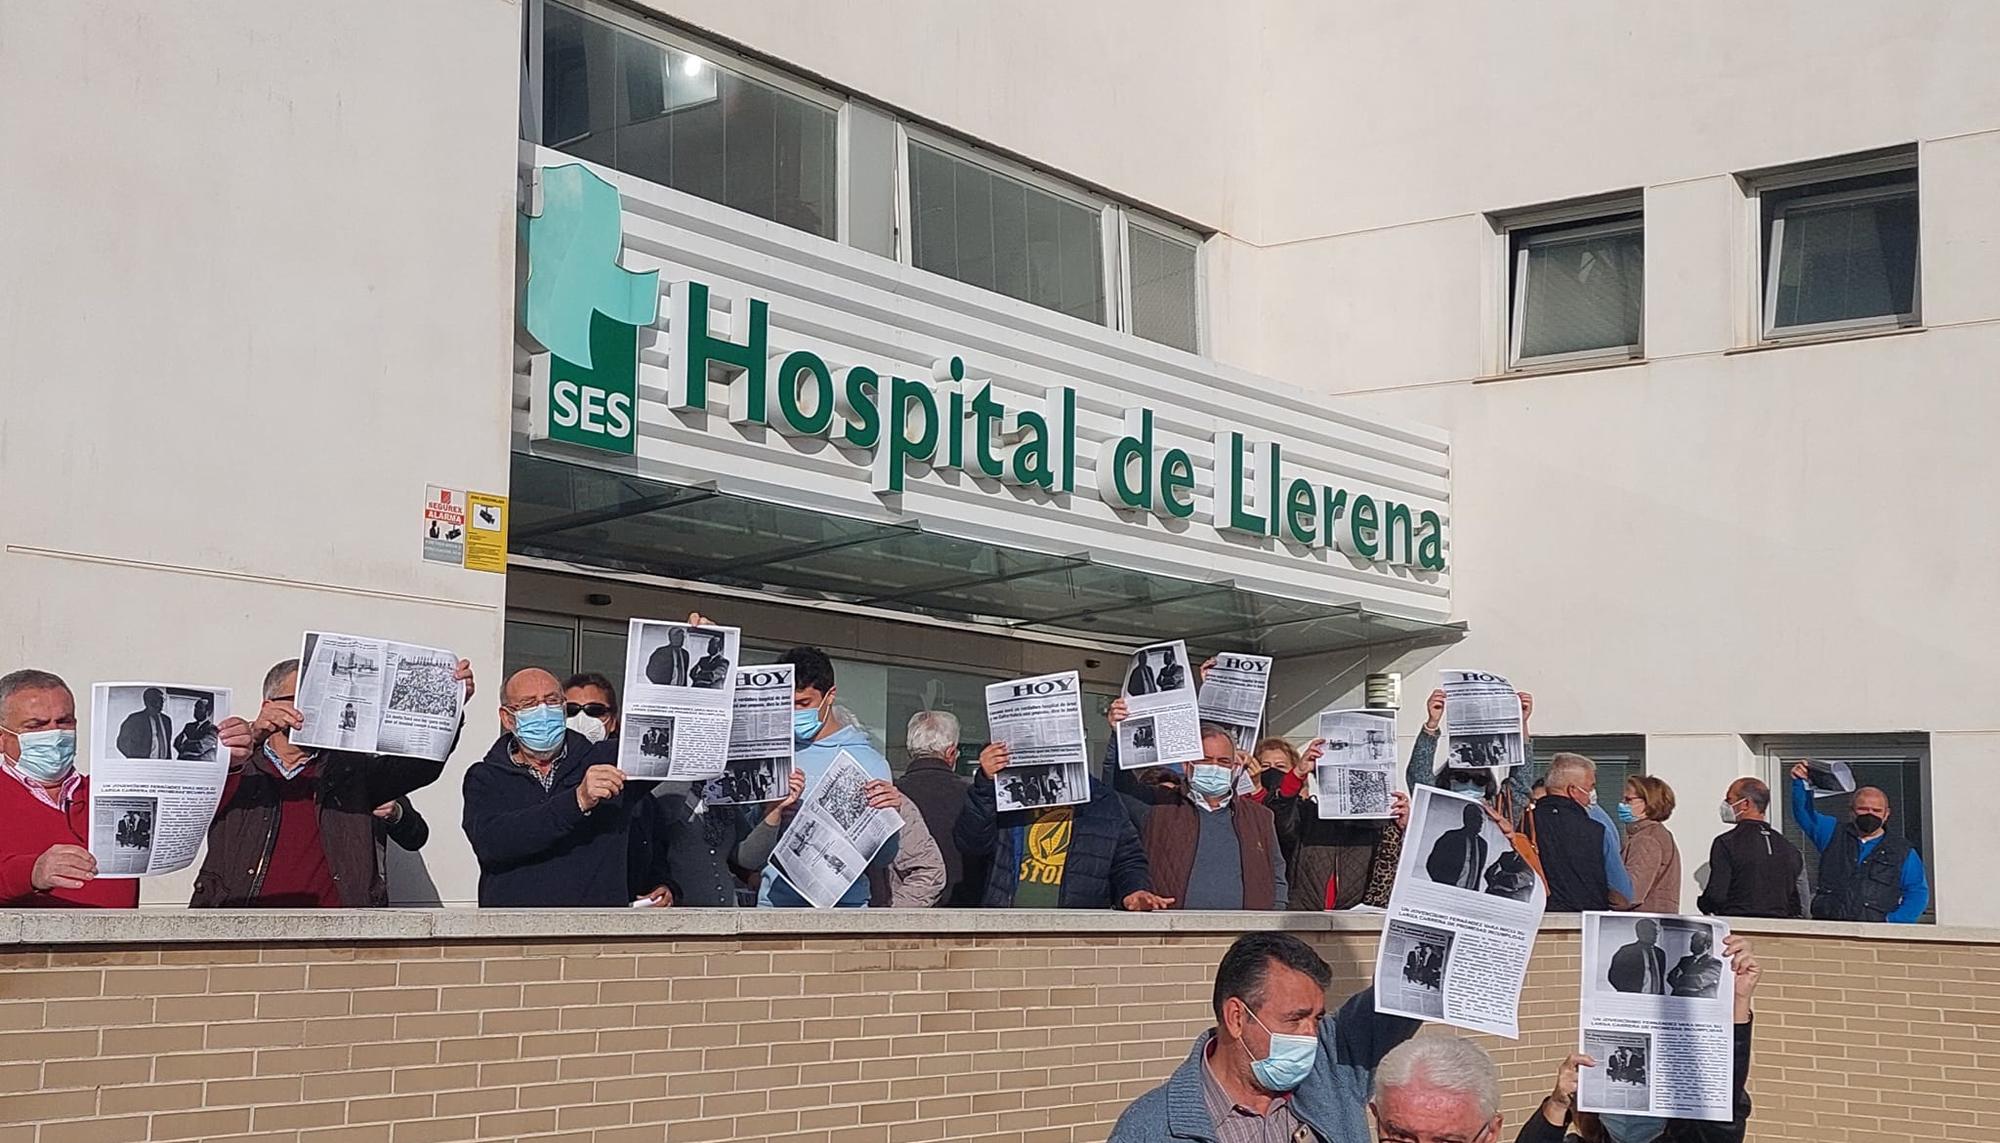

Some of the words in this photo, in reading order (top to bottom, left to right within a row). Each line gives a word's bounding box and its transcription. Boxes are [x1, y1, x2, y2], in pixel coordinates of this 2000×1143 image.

[553, 380, 632, 438] SES
[687, 280, 1077, 494] Hospital
[1113, 407, 1196, 520] de
[1230, 430, 1446, 573] Llerena
[428, 502, 463, 514] SEGUREX
[428, 510, 462, 523] ALARMA
[1226, 658, 1268, 672] HOY
[736, 670, 792, 687] HOY
[1013, 677, 1076, 697] HOY
